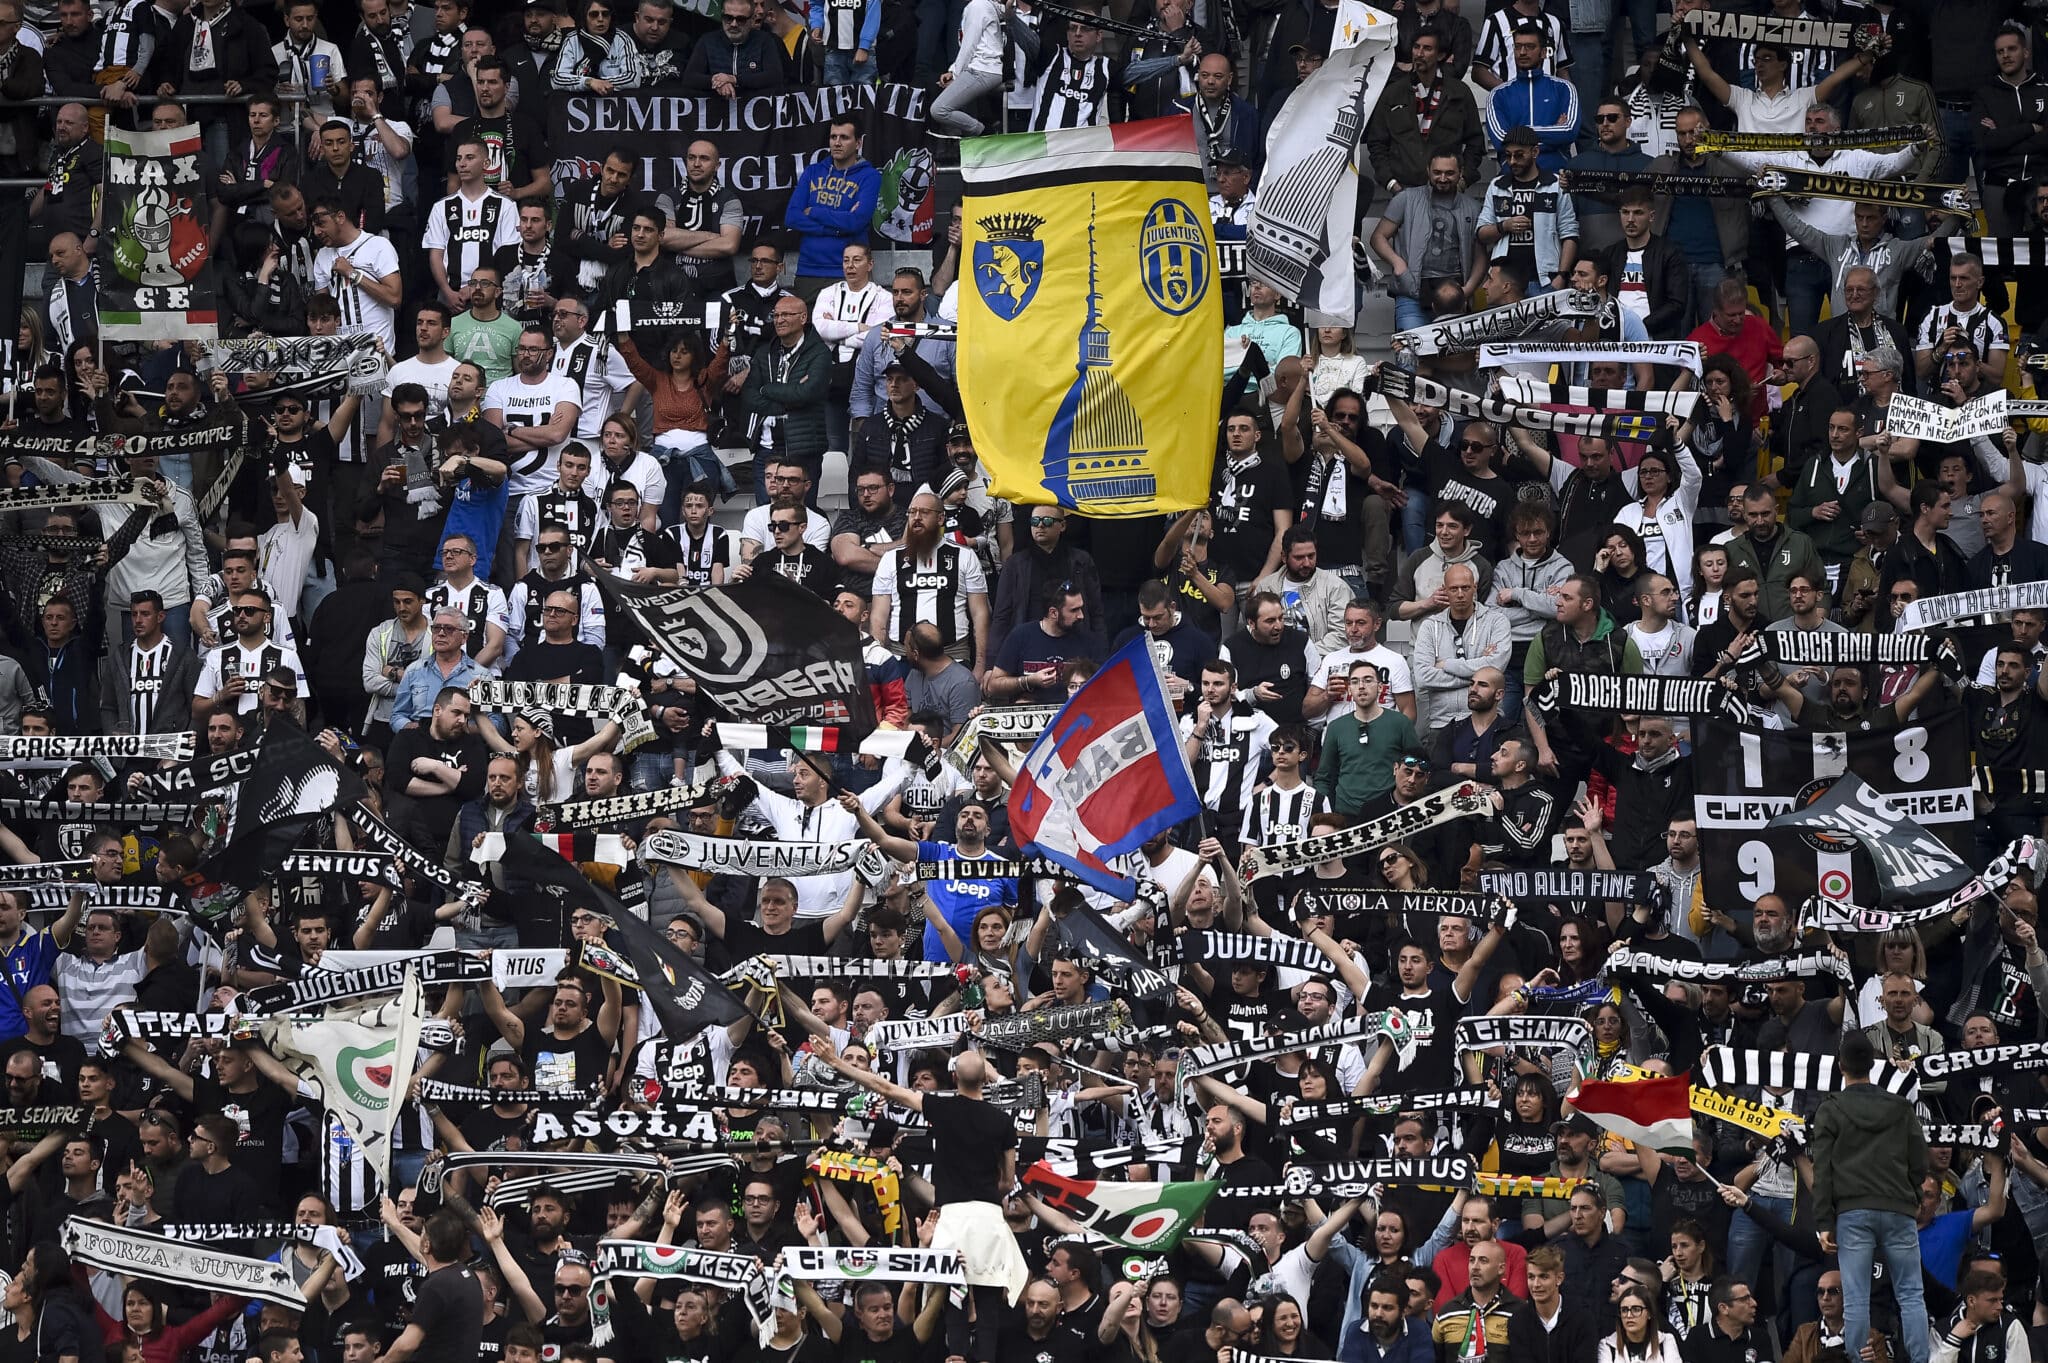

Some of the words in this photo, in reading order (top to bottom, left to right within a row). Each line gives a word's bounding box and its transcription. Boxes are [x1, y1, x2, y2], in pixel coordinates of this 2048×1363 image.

[1058, 84, 1089, 103] Jeep
[567, 83, 926, 132] SEMPLICEMENTE
[110, 155, 200, 185] MAX
[1803, 175, 1925, 201] JUVENTUS
[454, 226, 489, 244] Jeep
[1146, 225, 1200, 245] JUVENTUS
[636, 316, 701, 326] JUVENTUS
[507, 395, 551, 409] JUVENTUS
[1414, 376, 1607, 437] DRUGHI
[1890, 405, 1931, 424] RIMARRAI
[1974, 406, 1990, 418] CON
[1992, 400, 2004, 413] ME
[1893, 395, 1928, 411] ANCHE
[1931, 404, 1943, 416] SE
[13, 436, 73, 453] SEMPRE
[178, 424, 234, 447] SEMPRE
[1888, 418, 1921, 436] BARZA
[1438, 479, 1498, 518] JUVENTUS
[1637, 523, 1662, 537] Jee
[687, 569, 710, 585] eep
[905, 574, 949, 590] Jeep
[1918, 596, 1964, 623] FINO
[1967, 587, 2010, 612] ALLA
[2013, 581, 2048, 607] FIN
[1778, 631, 1831, 663] BLACK
[1838, 632, 1871, 662] AND
[1570, 673, 1620, 707] BLACK
[1626, 677, 1658, 711] AND
[1663, 680, 1716, 713] WHITE
[13, 737, 140, 757] CRIS7IANO
[1739, 731, 1763, 788] 1
[1894, 726, 1930, 782] 8
[560, 779, 706, 822] FIGHTERS
[1259, 796, 1446, 864] FIGHTERS
[1266, 821, 1304, 837] Jeep
[281, 855, 381, 878] VENTUS
[698, 839, 852, 869] JUVENTUS
[0, 866, 64, 880] NTUS
[1737, 840, 1775, 902] 9
[945, 880, 991, 899] Jeep
[1535, 872, 1585, 897] ALLA
[1590, 872, 1637, 899] FINE
[1318, 896, 1389, 911] VIOLA
[1403, 895, 1486, 917] MERDA!
[1202, 930, 1338, 974] JUVENTUS
[506, 957, 546, 976] NTUS
[289, 963, 406, 1006] JUVENTUS
[135, 1010, 229, 1038] TRAD
[881, 1013, 970, 1042] JUVENTU
[665, 1062, 706, 1083] Jeep
[2013, 1057, 2048, 1071] CURV
[1412, 1091, 1482, 1111] SiAM
[22, 1104, 85, 1125] SEMPRE
[1702, 1101, 1736, 1117] CLUB
[1739, 1109, 1771, 1131] 1897
[1921, 1123, 2001, 1149] TERS
[1321, 1157, 1468, 1182] JUVENTUS
[84, 1232, 170, 1269] FORZA
[195, 1257, 265, 1284] JUVE
[686, 1250, 757, 1285] PRESE
[888, 1252, 963, 1276] SiAM
